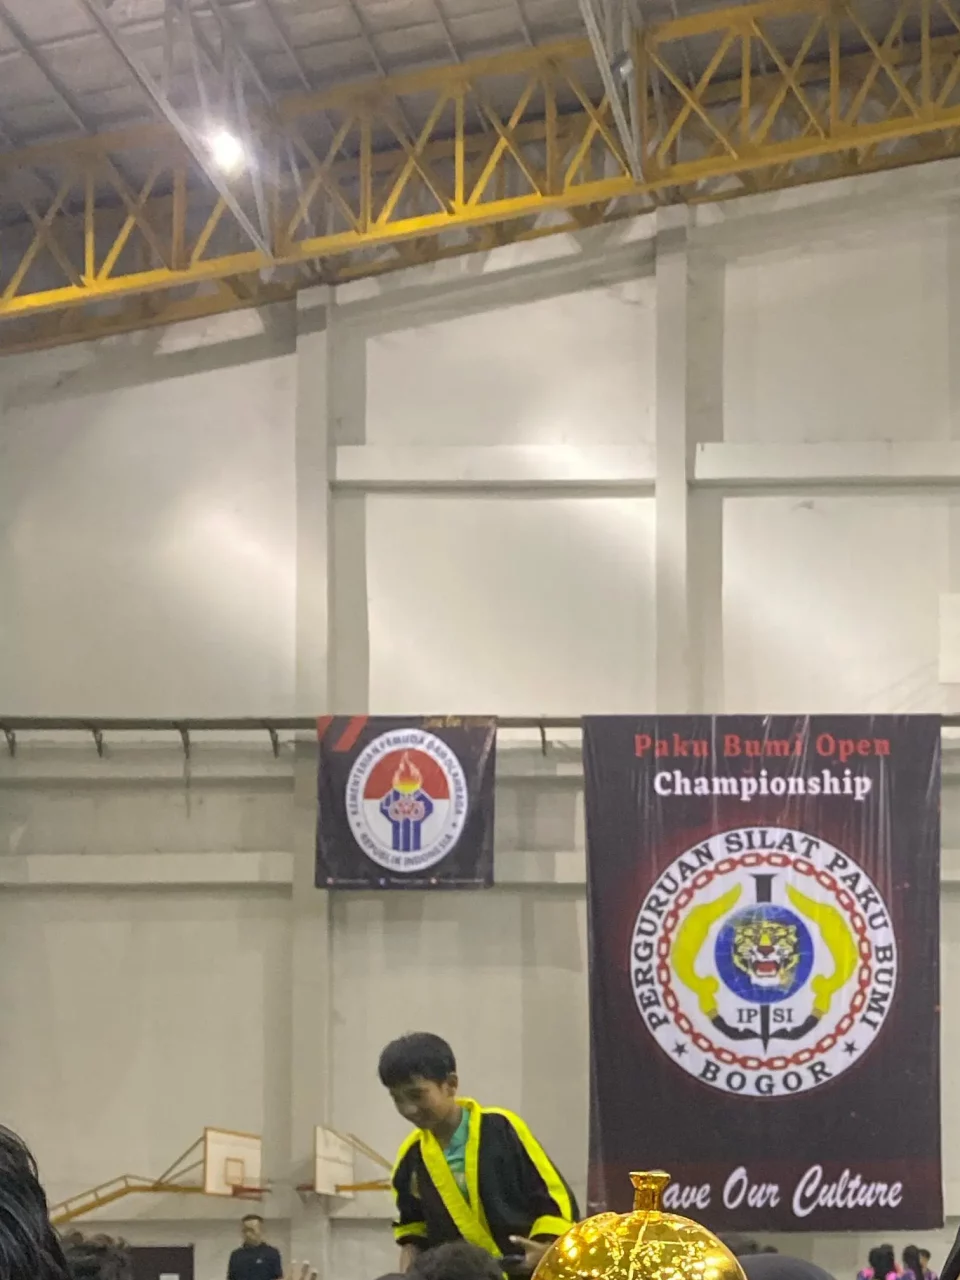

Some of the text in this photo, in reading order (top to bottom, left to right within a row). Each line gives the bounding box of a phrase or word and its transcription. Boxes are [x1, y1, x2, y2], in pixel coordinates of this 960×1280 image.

[634, 733, 891, 763] Paku Bumi Open
[653, 768, 873, 801] Championship
[633, 829, 894, 1032] PERGURUAN SILAT PAKU BUMI
[699, 1059, 833, 1095] BOGOR
[661, 1163, 903, 1218] ave Our Culture
